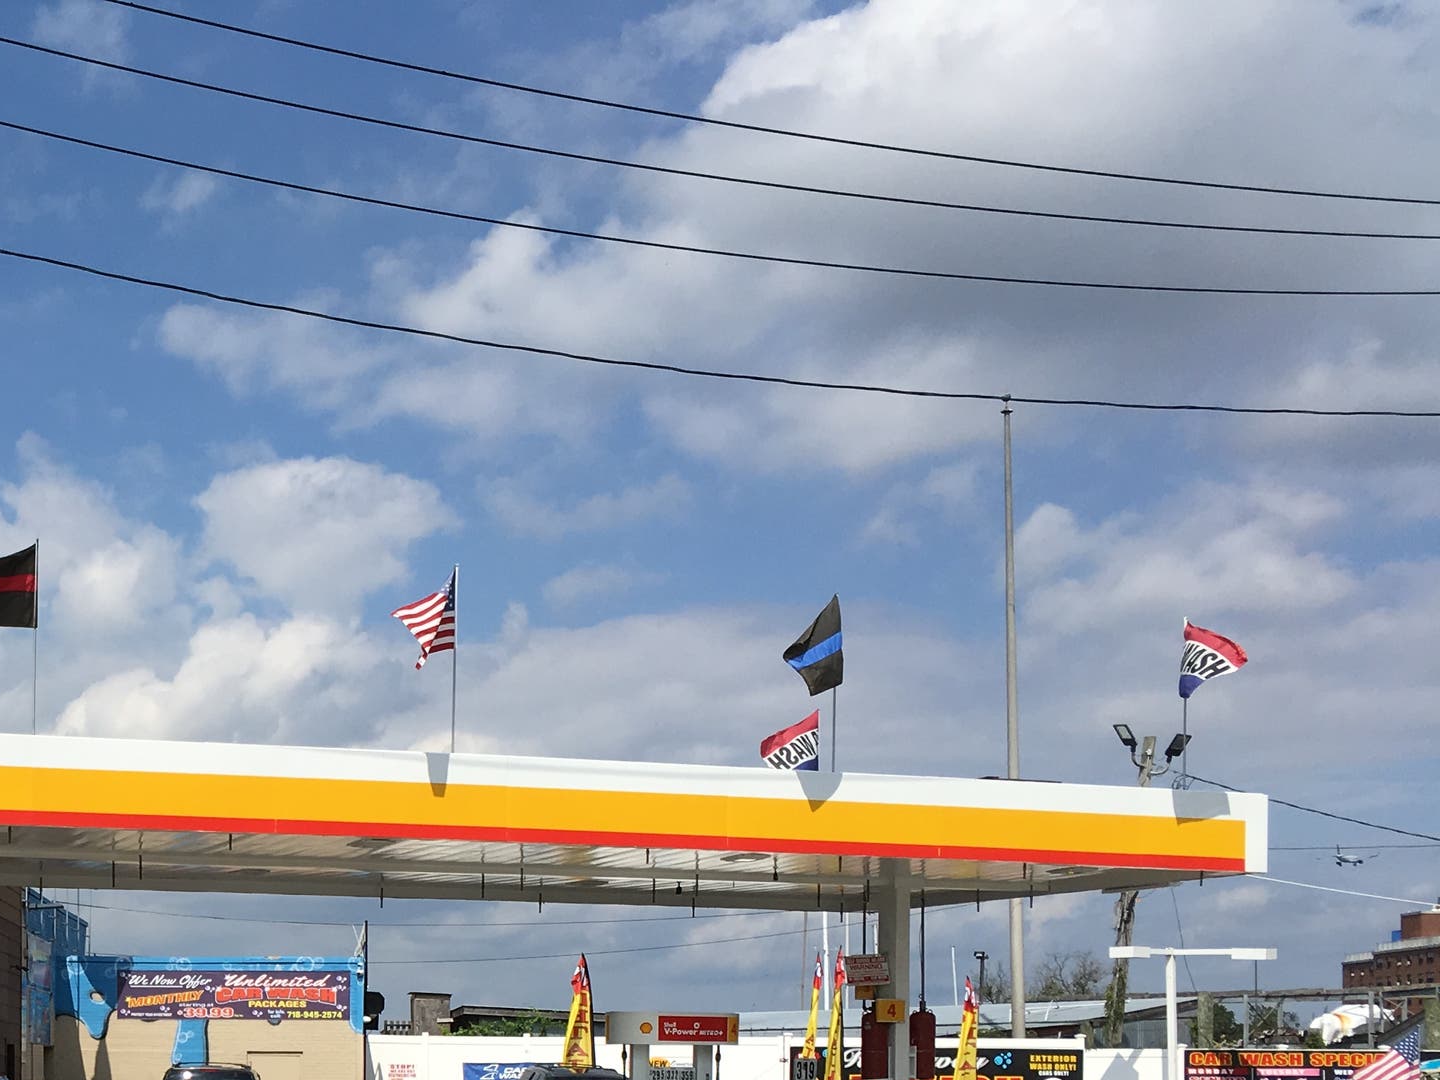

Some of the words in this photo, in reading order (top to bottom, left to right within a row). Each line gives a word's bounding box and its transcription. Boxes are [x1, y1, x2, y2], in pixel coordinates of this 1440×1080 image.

[129, 974, 148, 985] We
[150, 974, 177, 985] Now
[179, 974, 212, 988] Offer
[225, 974, 331, 987] Unlimited
[127, 990, 204, 1008] MONTHLY
[215, 987, 263, 1004] CAR
[266, 987, 337, 1005] WASH
[248, 1000, 307, 1008] PACKAGES
[888, 1004, 896, 1017] 4
[1190, 1052, 1233, 1067] CAR
[1239, 1052, 1304, 1067] WASH
[796, 1061, 815, 1080] 319
[1054, 1063, 1077, 1071] ONLY!
